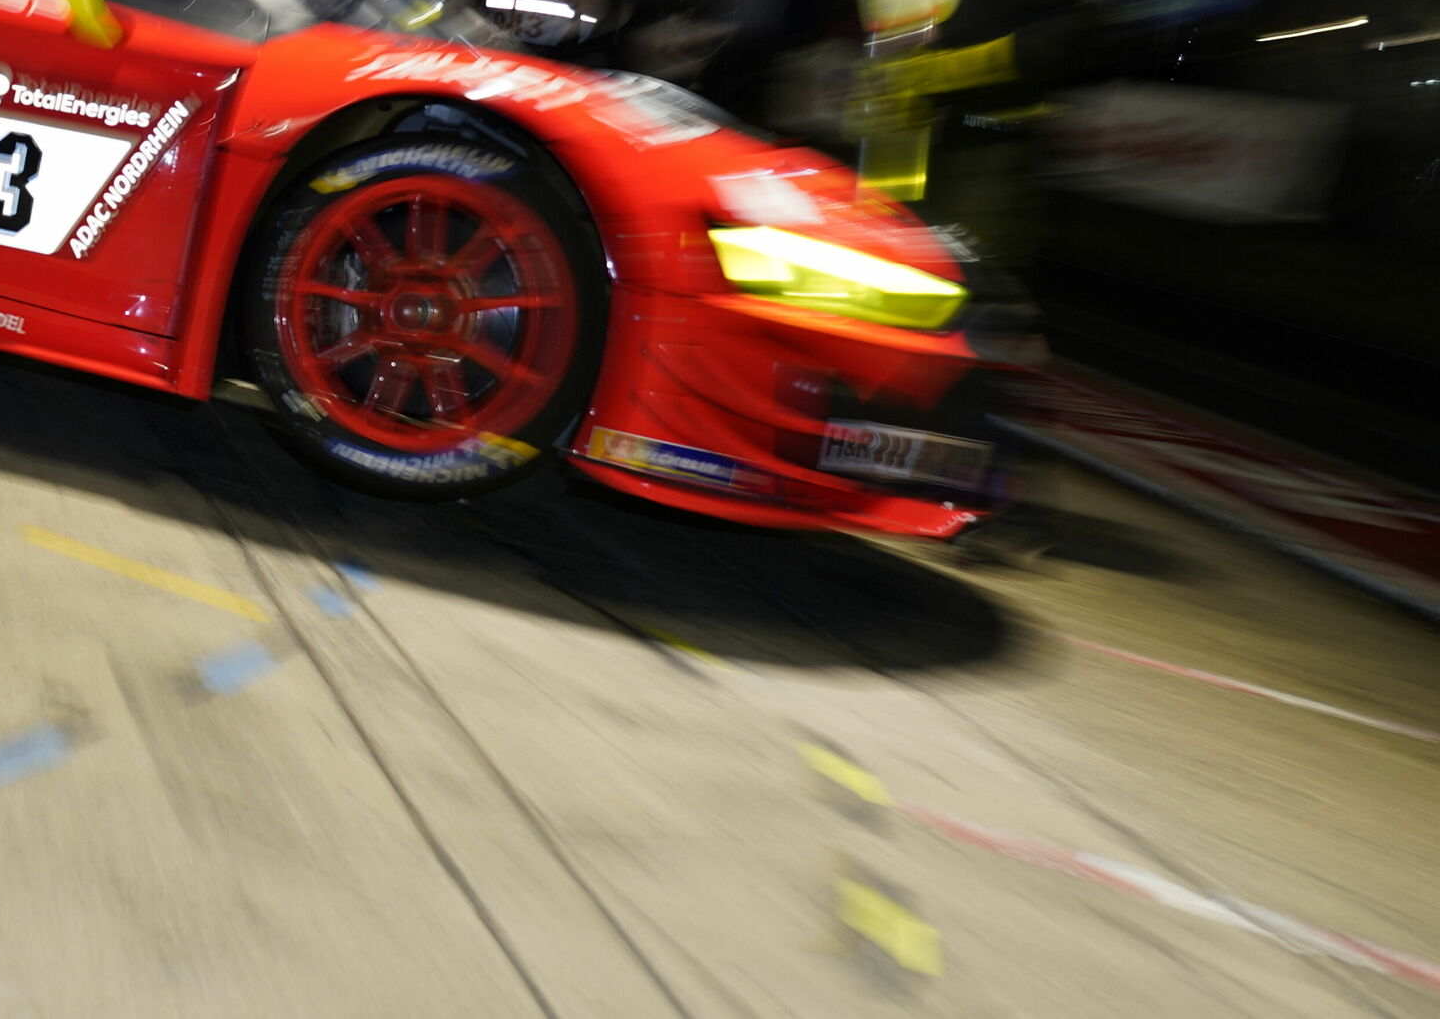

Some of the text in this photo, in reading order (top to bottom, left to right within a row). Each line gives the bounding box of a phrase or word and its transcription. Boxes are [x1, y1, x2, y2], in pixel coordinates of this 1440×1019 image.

[11, 84, 151, 128] TotalEnergies
[69, 100, 190, 260] ADAC NORDRHEIN
